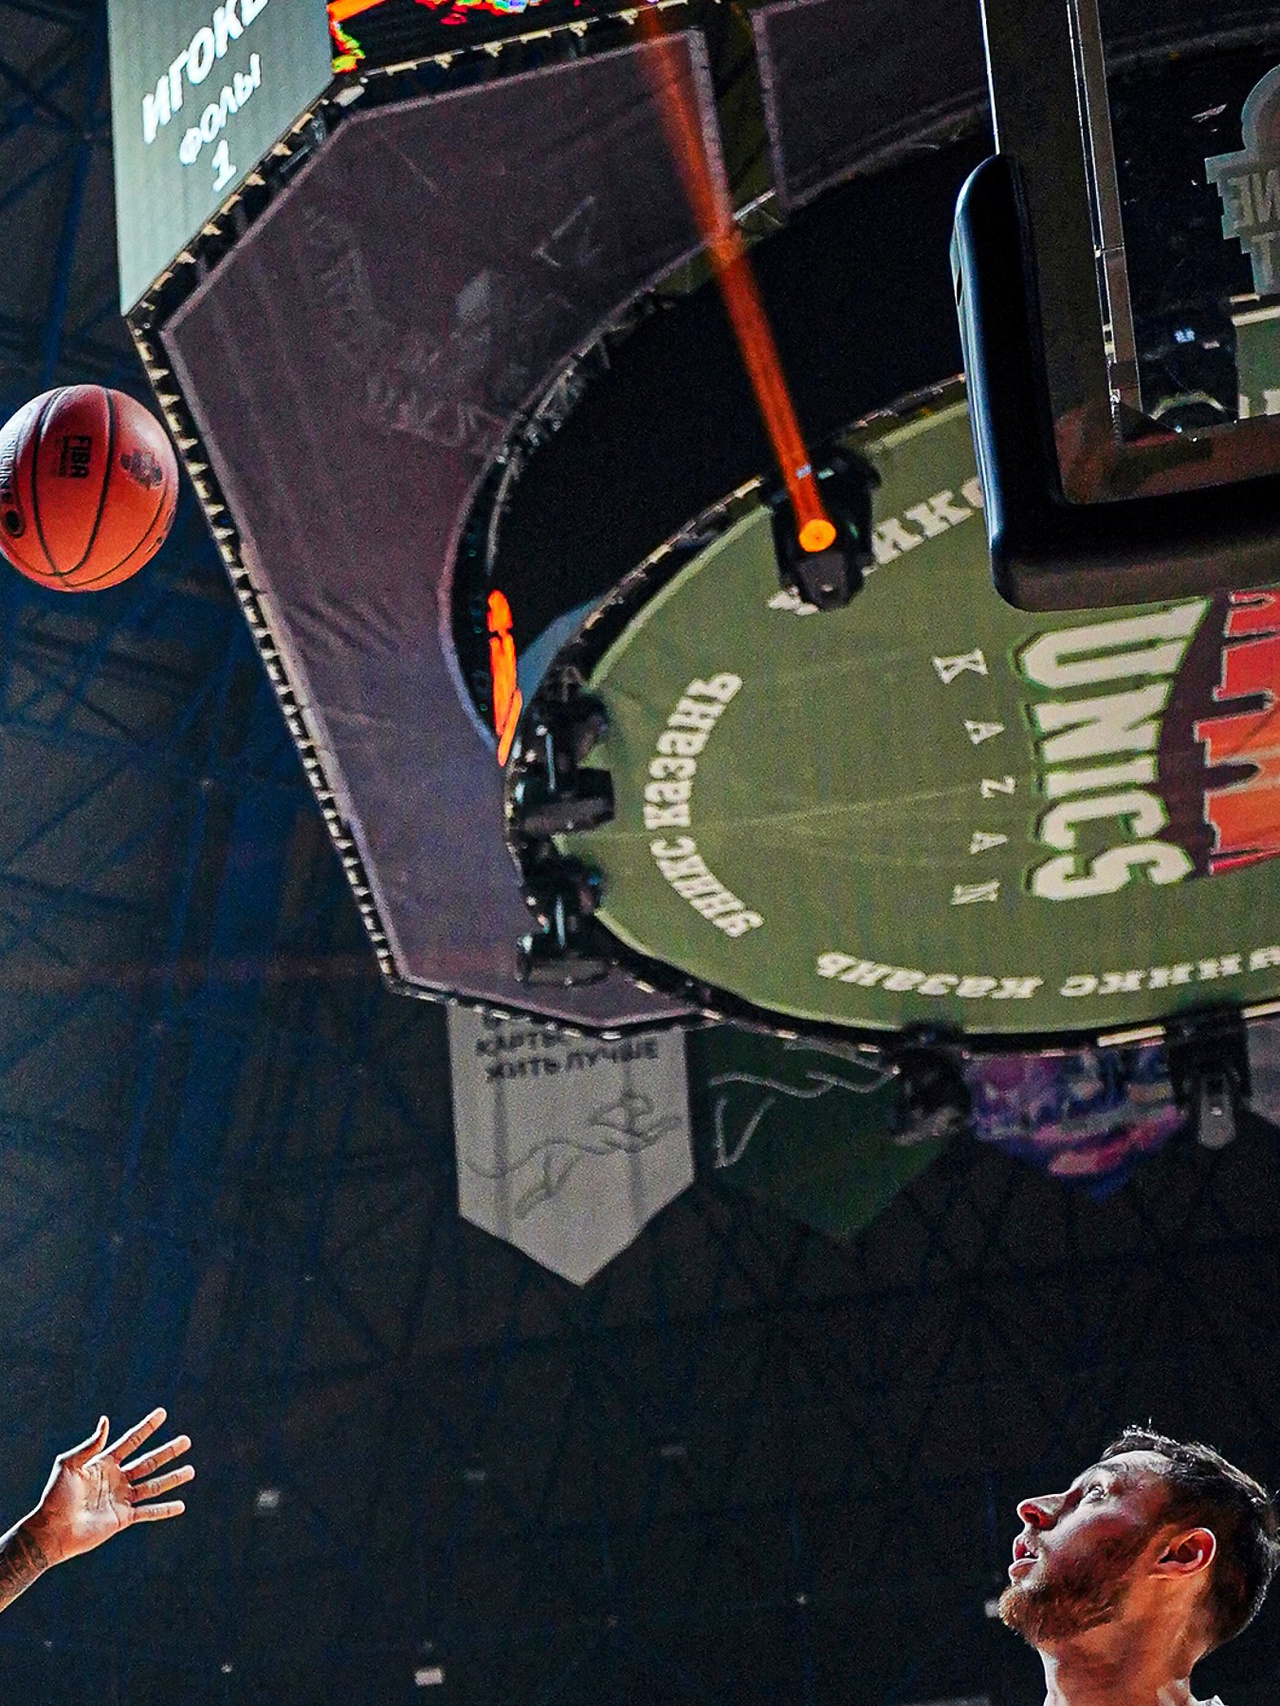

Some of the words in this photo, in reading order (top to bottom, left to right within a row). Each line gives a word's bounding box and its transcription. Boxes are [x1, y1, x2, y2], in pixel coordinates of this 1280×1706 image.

[179, 53, 261, 165] ФОЛЫ
[211, 139, 237, 193] 1
[1023, 599, 1207, 901] UNICS
